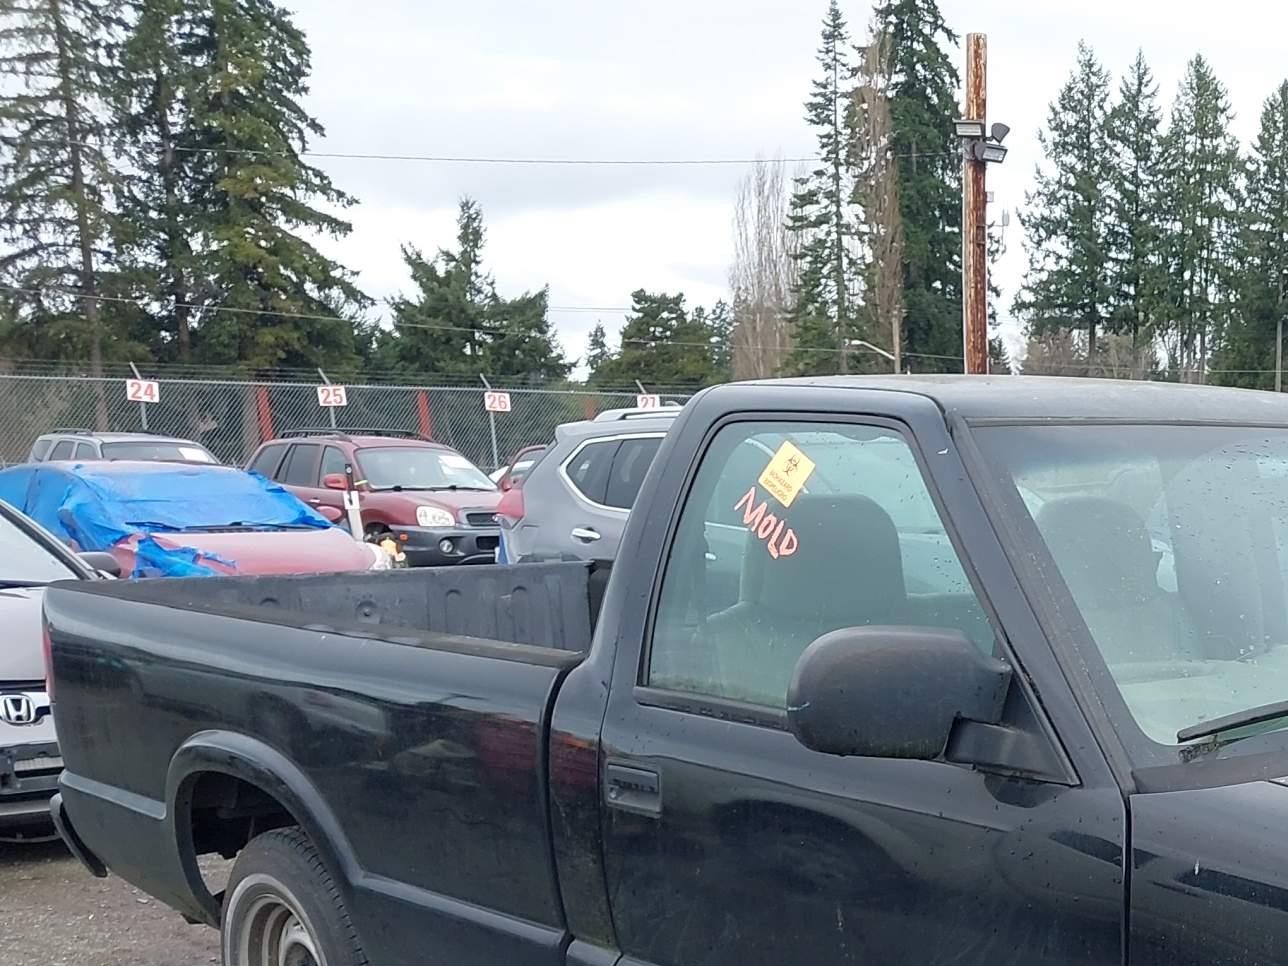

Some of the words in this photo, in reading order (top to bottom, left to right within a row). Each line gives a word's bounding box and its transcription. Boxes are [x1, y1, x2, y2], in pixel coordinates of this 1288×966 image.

[130, 382, 156, 400] 24
[321, 388, 344, 404] 25
[487, 394, 508, 410] 26
[640, 396, 656, 409] 27
[734, 486, 798, 560] MOLD
